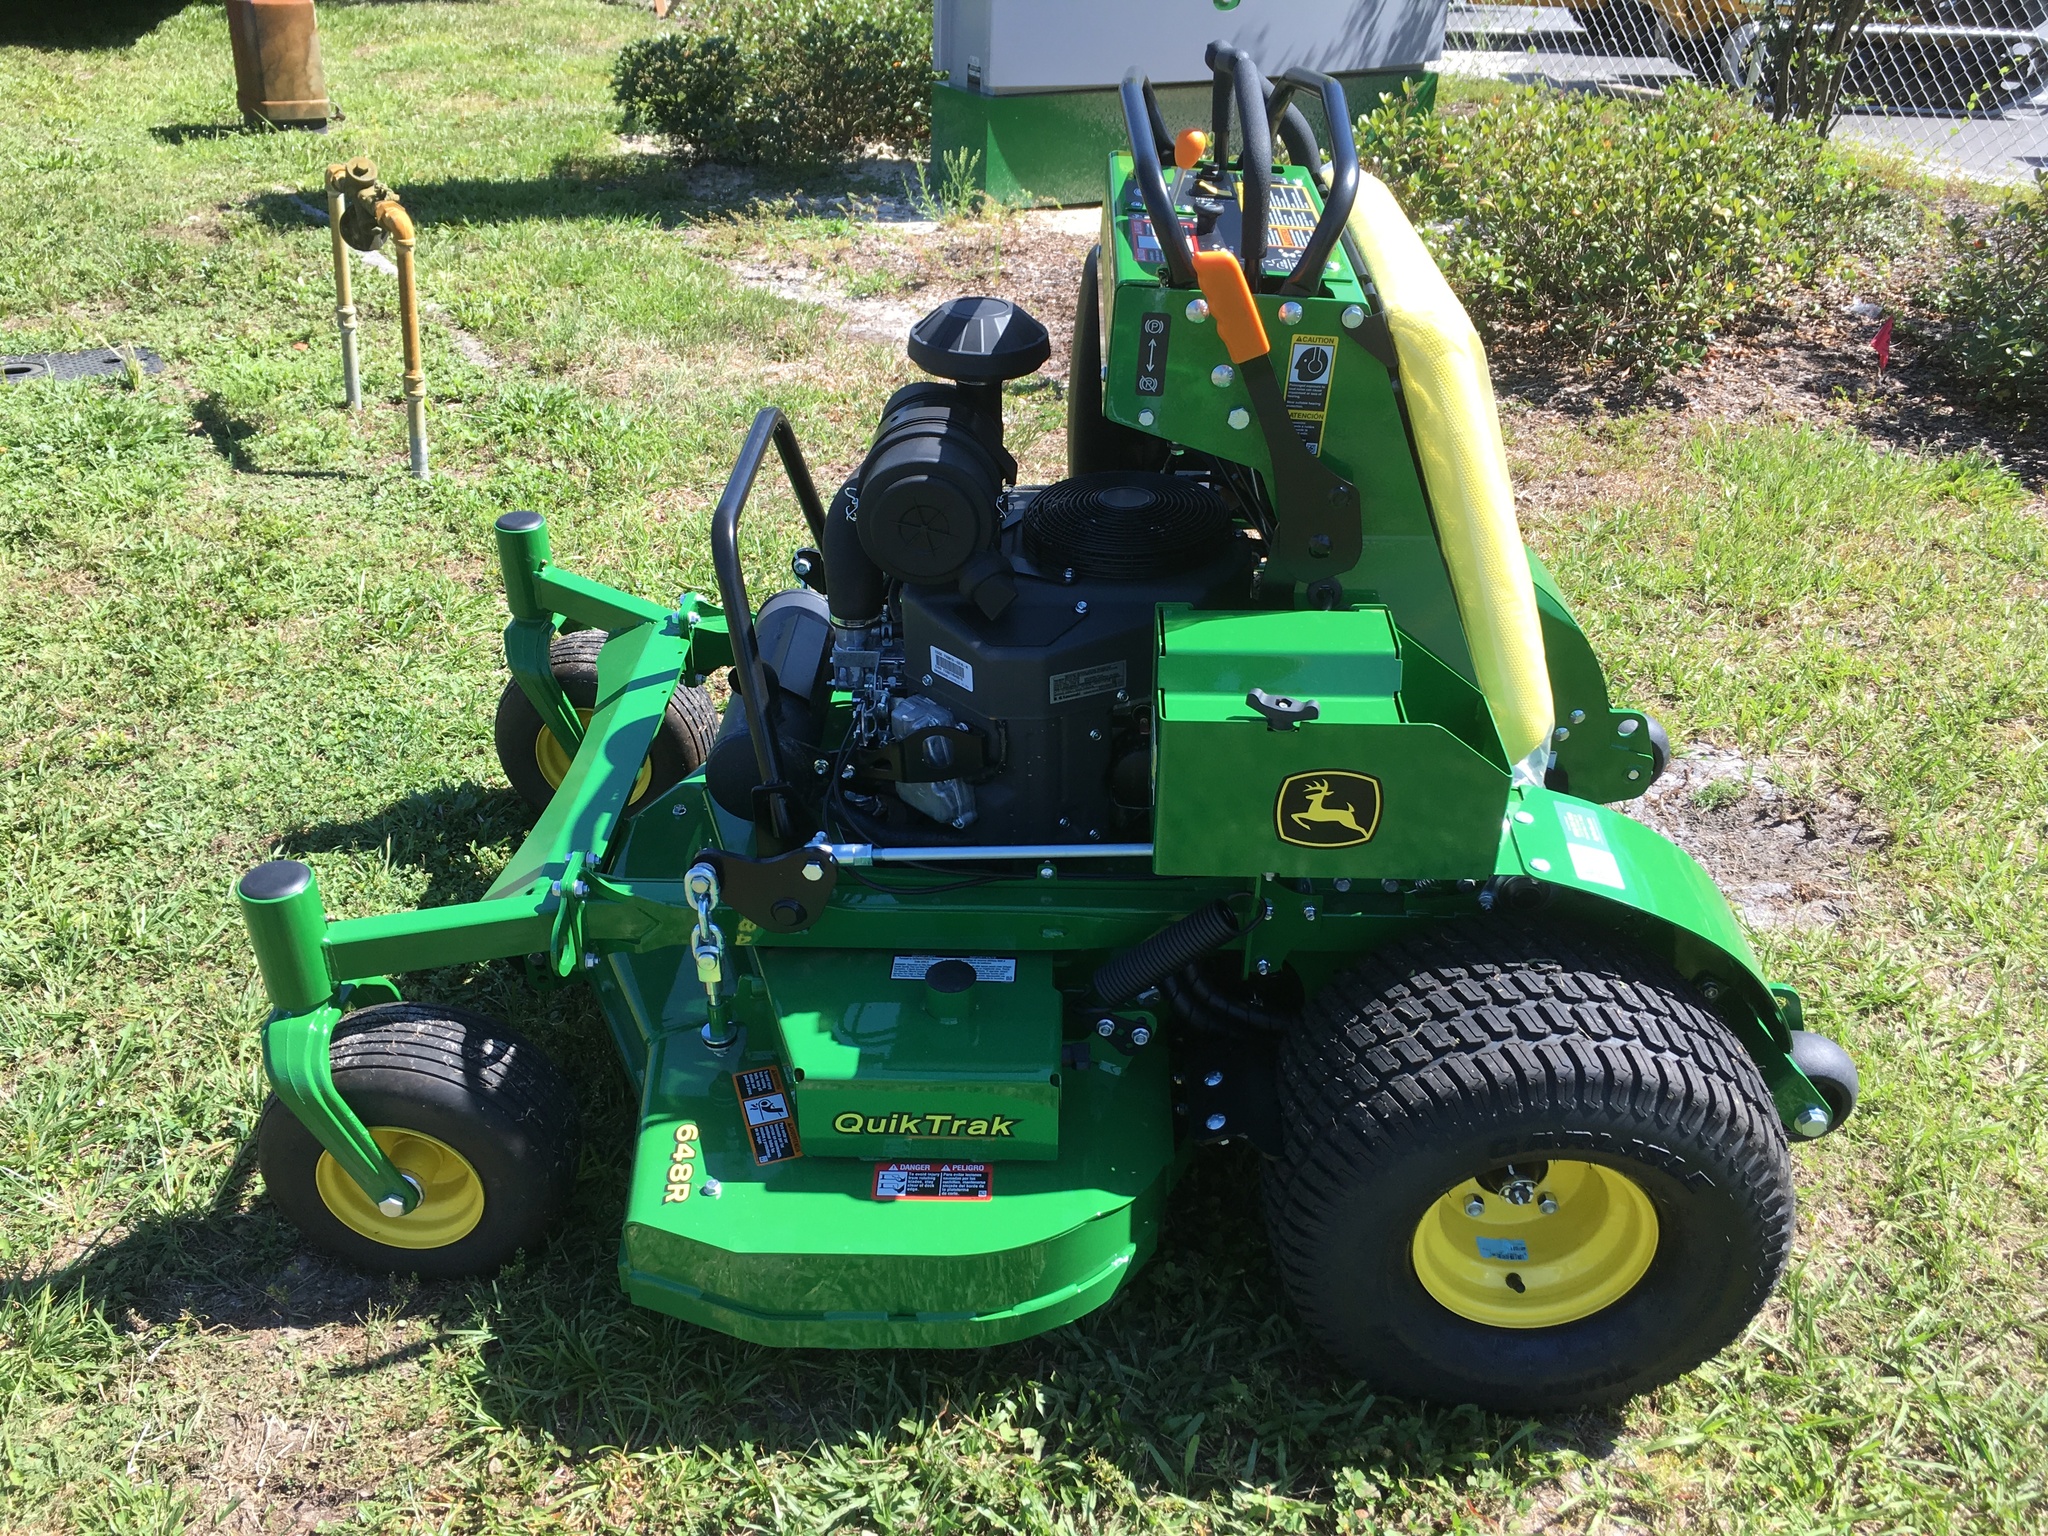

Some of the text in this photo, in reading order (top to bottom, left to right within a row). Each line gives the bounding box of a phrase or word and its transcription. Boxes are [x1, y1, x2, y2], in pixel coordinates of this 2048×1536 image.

[1303, 336, 1335, 344] CAUTION
[833, 1112, 1015, 1136] QuikTrak
[663, 1123, 699, 1204] 648R
